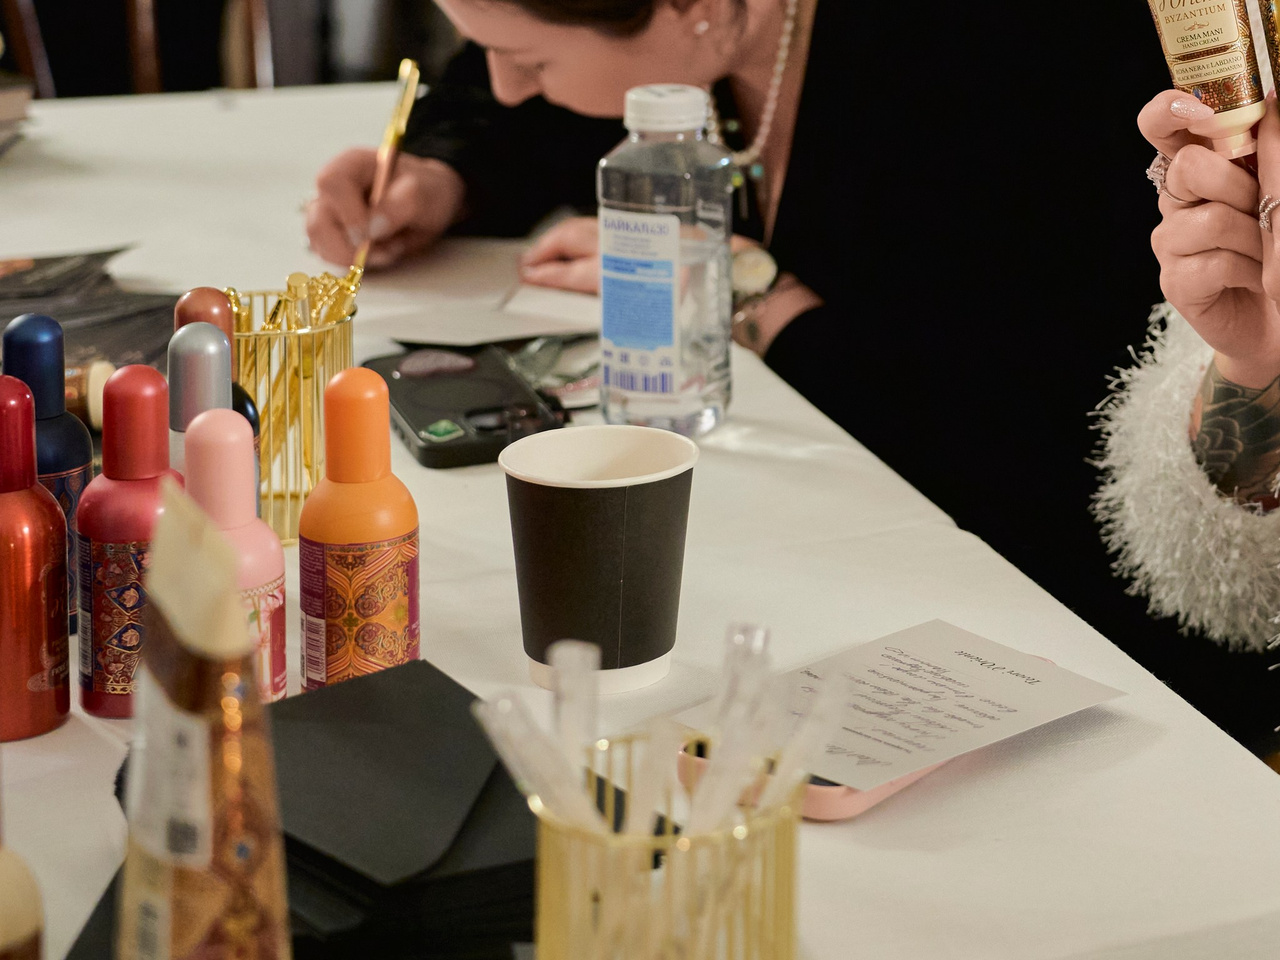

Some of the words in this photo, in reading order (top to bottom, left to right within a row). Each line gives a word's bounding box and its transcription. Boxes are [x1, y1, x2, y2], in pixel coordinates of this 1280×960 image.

[1164, 3, 1226, 24] BYZANTIUM
[1176, 32, 1203, 44] CREMA
[1202, 27, 1224, 38] MANI
[1182, 41, 1199, 49] HAND
[1199, 37, 1220, 46] CREAM
[1188, 65, 1206, 73] NERA
[1210, 56, 1242, 68] LABDANO
[1212, 63, 1243, 75] LABDANUM
